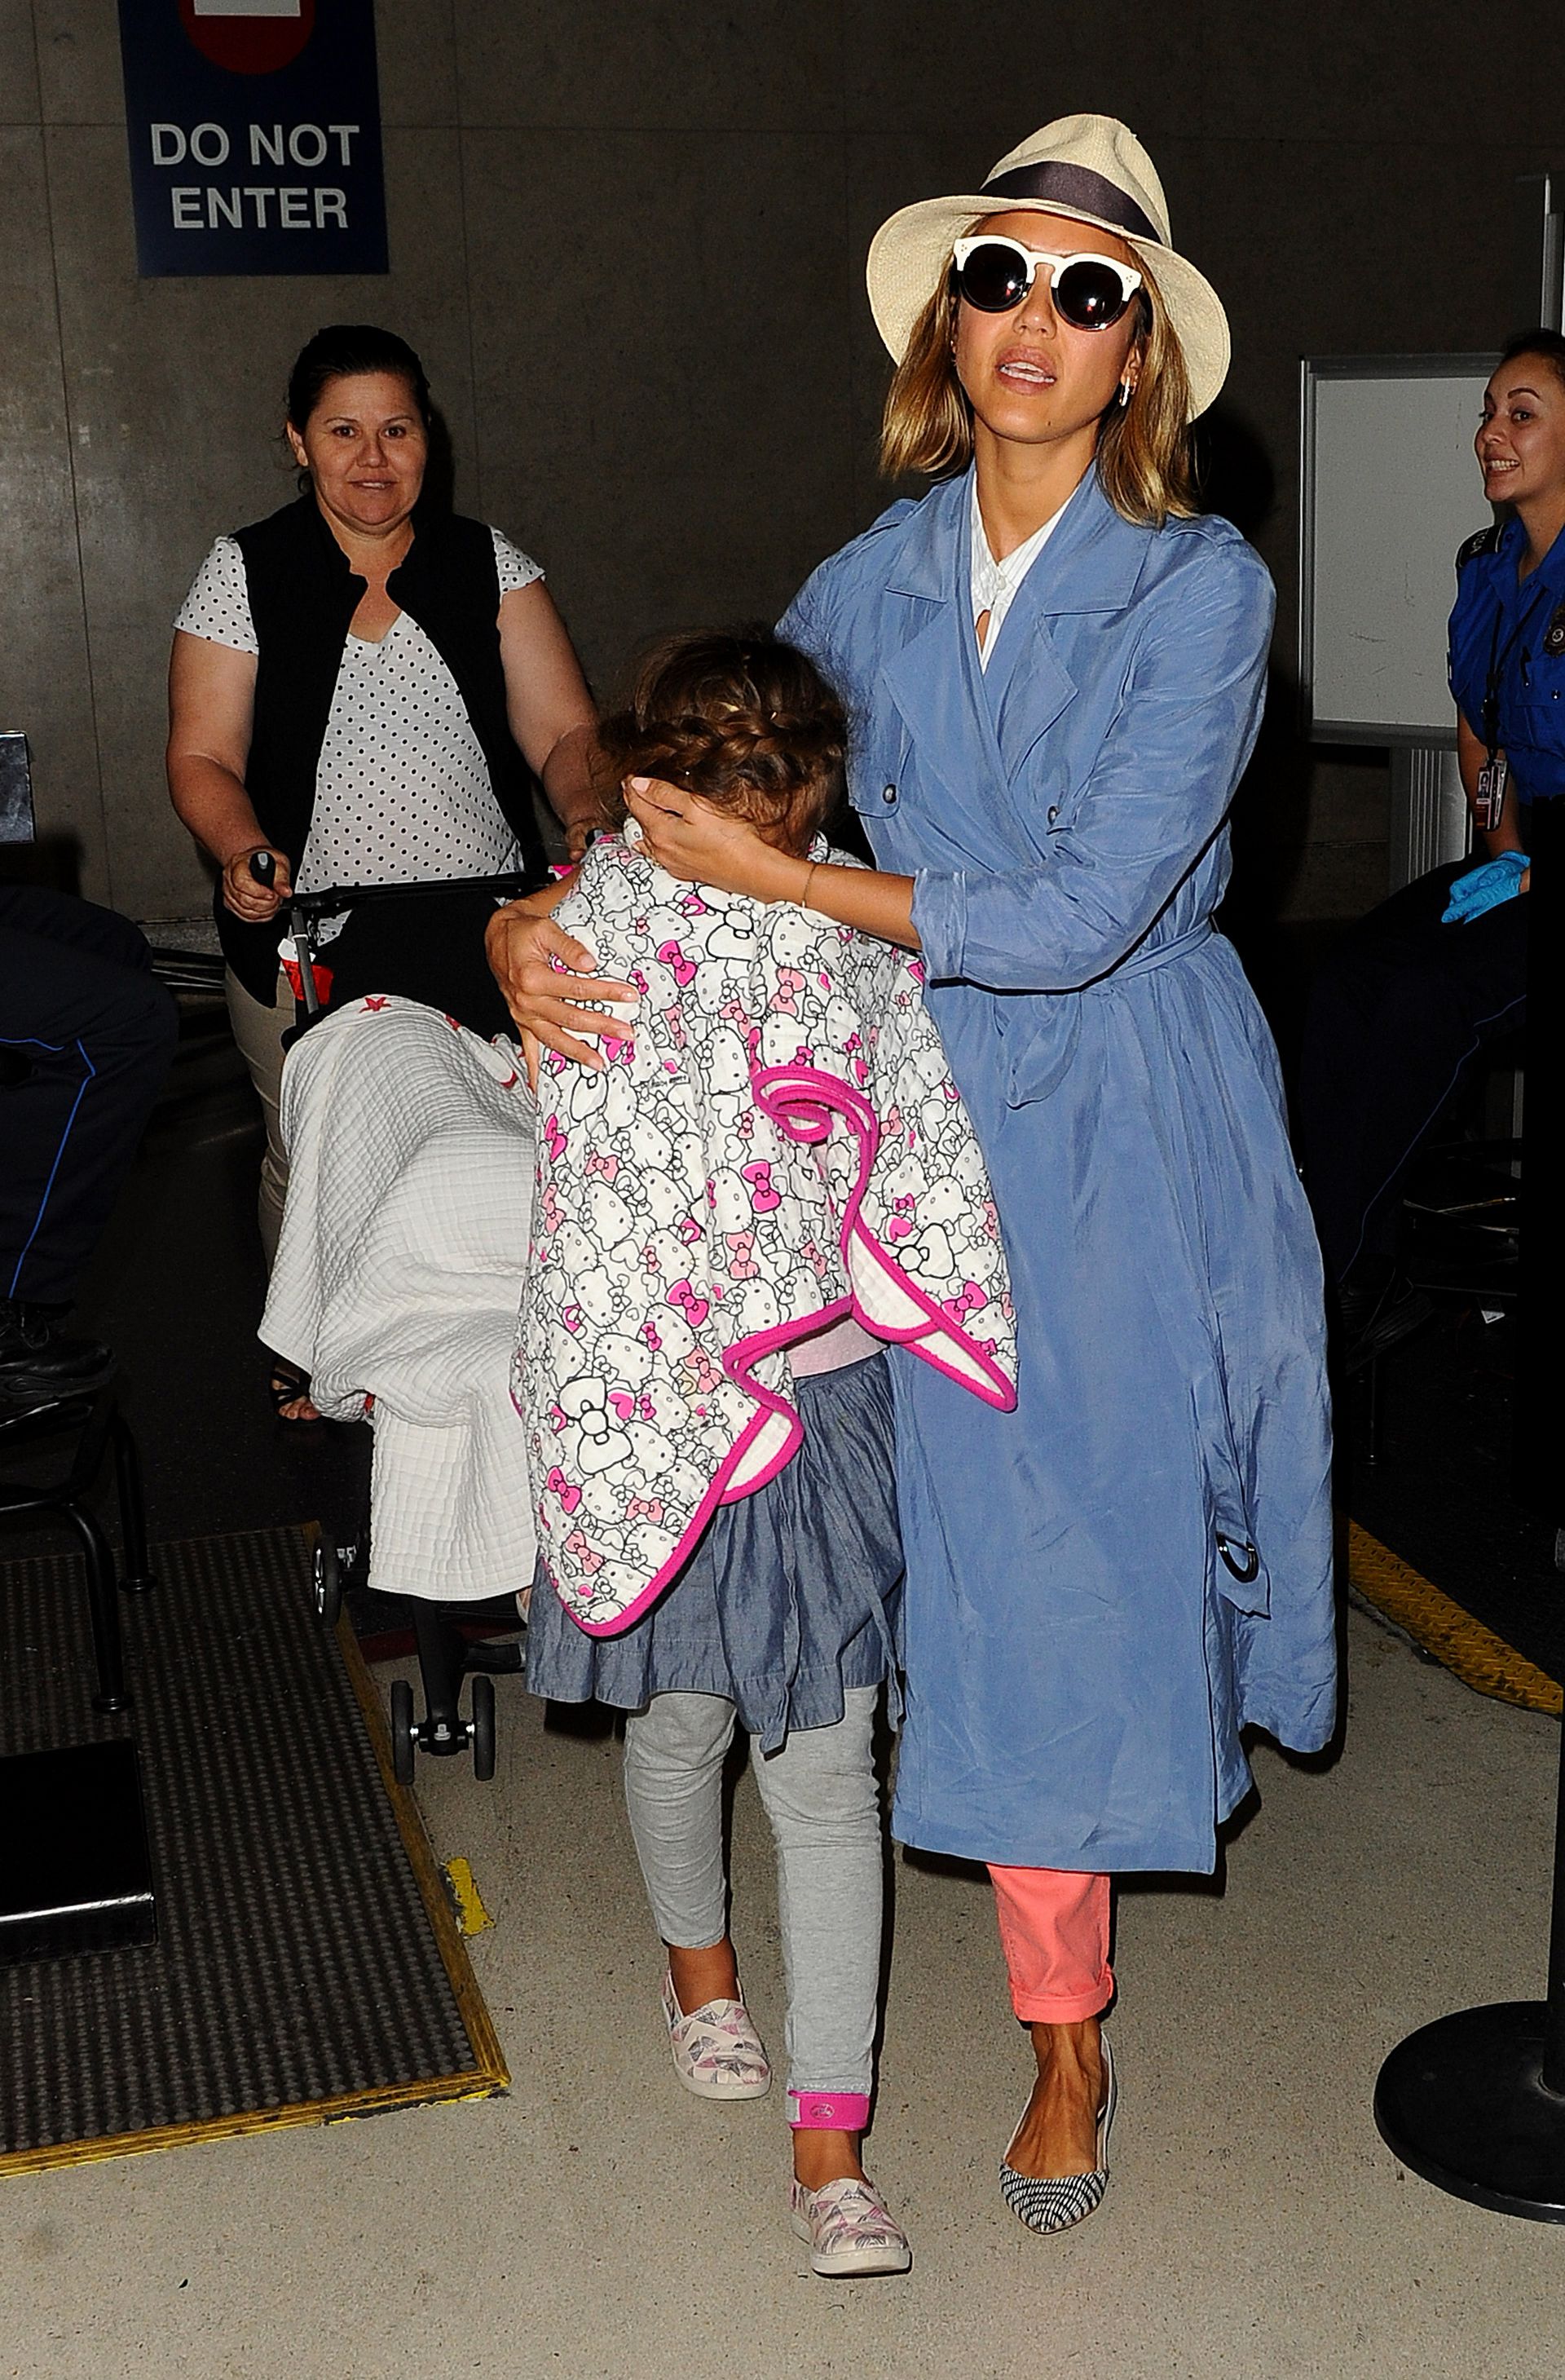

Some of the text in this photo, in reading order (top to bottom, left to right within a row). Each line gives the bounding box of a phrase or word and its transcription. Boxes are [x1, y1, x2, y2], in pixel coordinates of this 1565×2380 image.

[150, 123, 360, 167] DO NOT
[171, 188, 349, 229] ENTER
